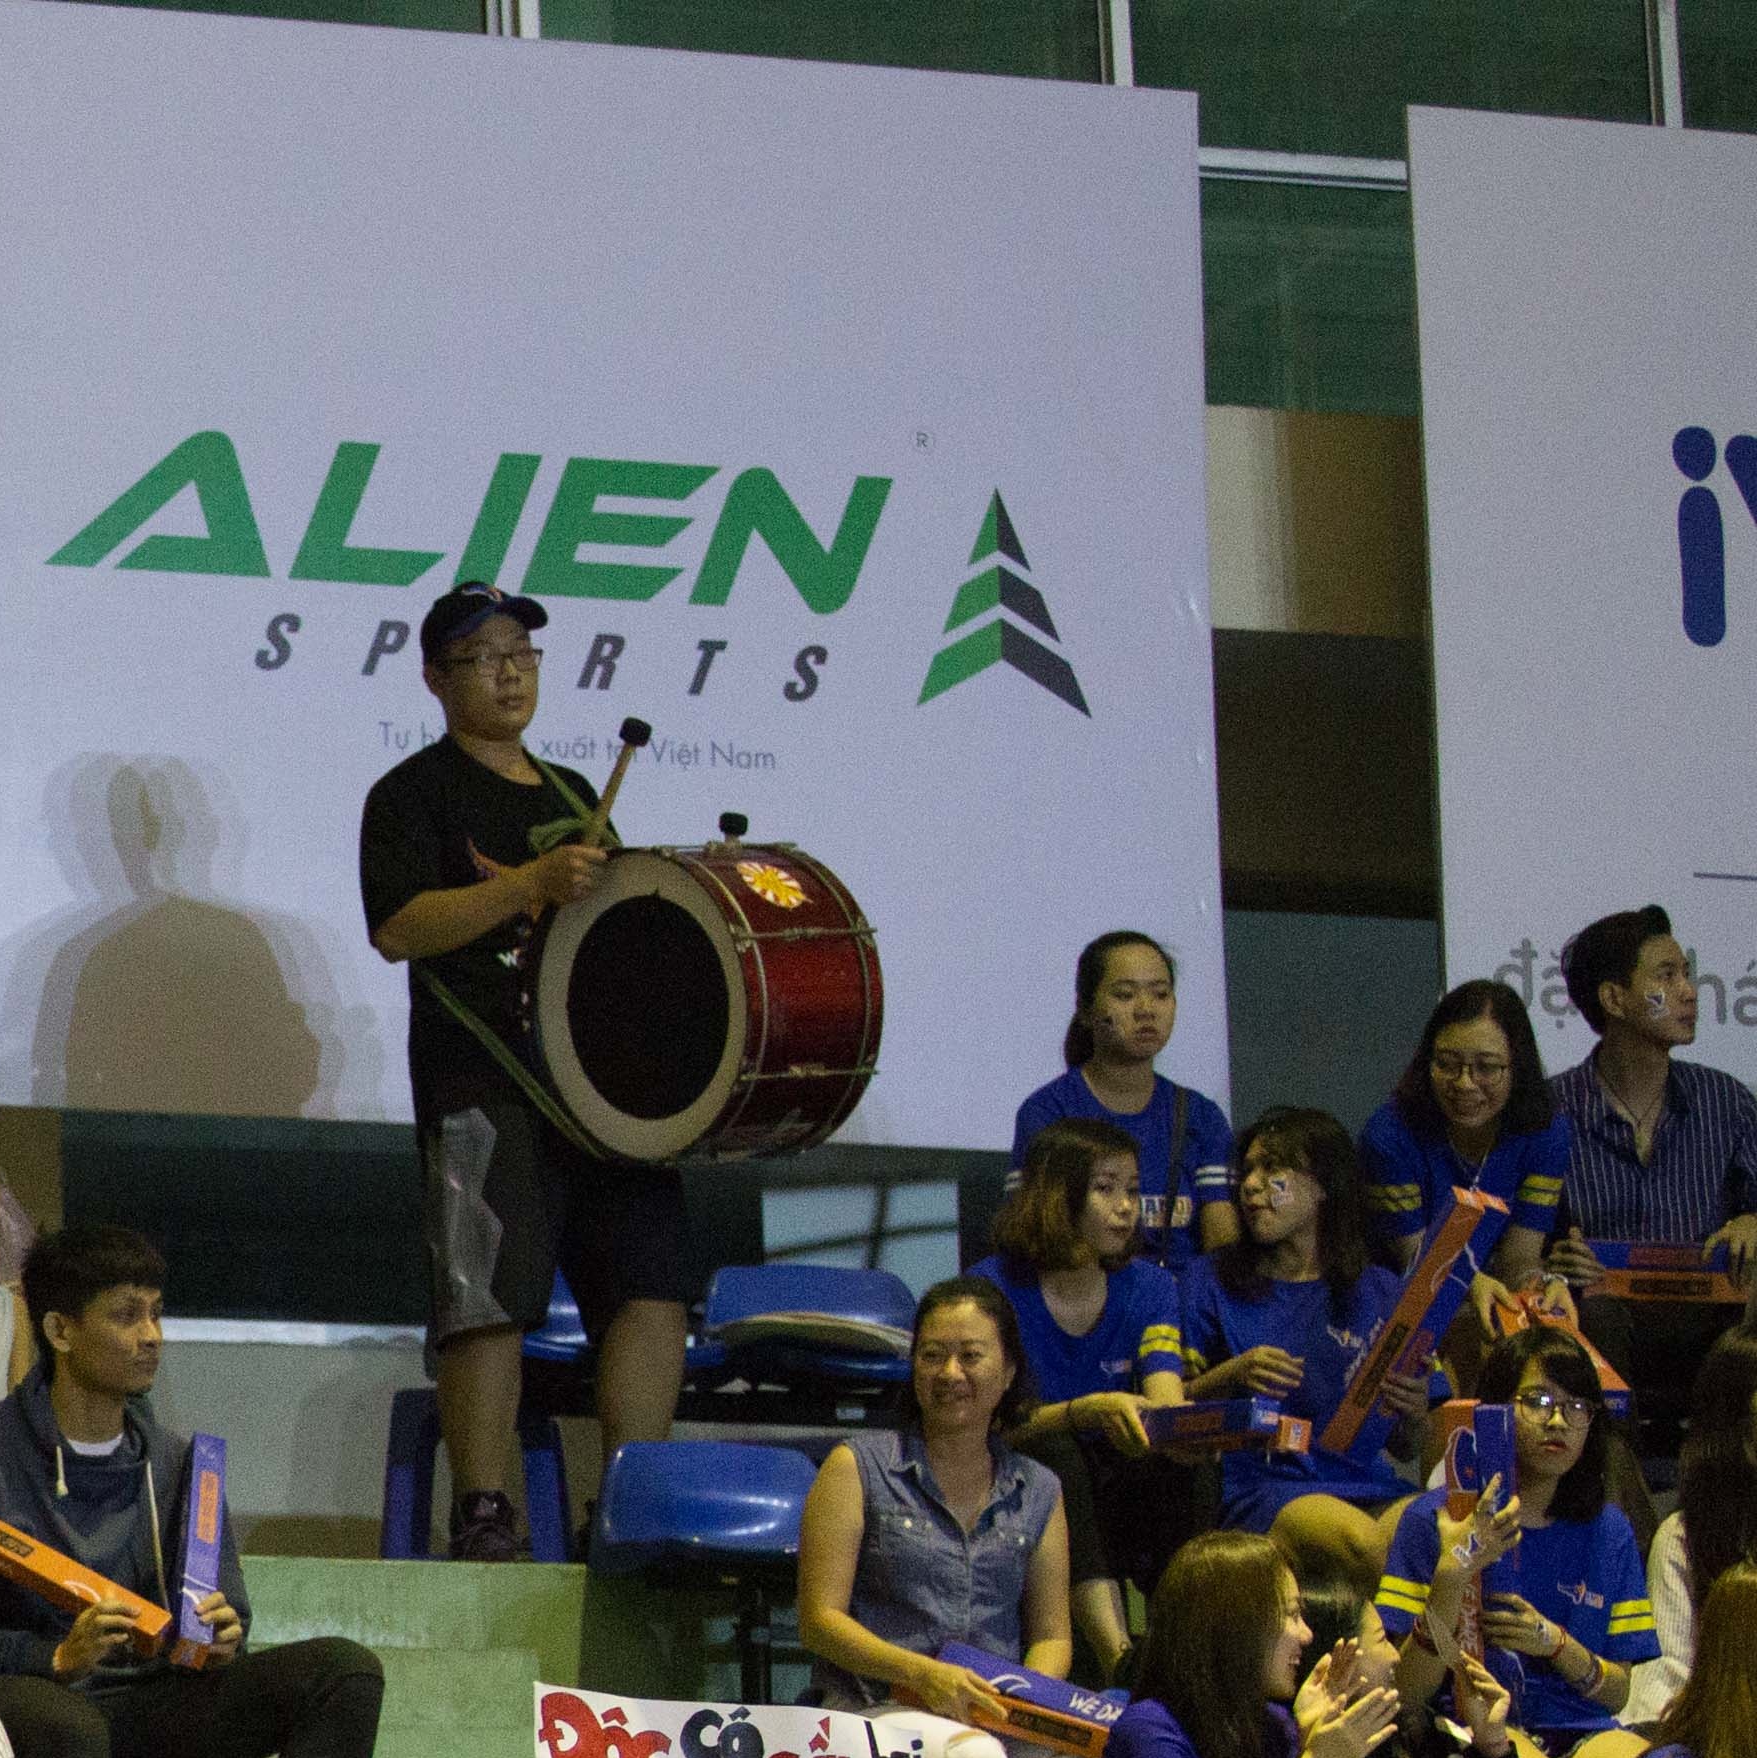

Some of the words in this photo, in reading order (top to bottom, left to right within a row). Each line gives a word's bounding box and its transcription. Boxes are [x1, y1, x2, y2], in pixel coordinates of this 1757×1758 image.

[44, 430, 894, 615] ALIEN
[254, 612, 829, 703] SPRTS
[1068, 1692, 1100, 1715] WE
